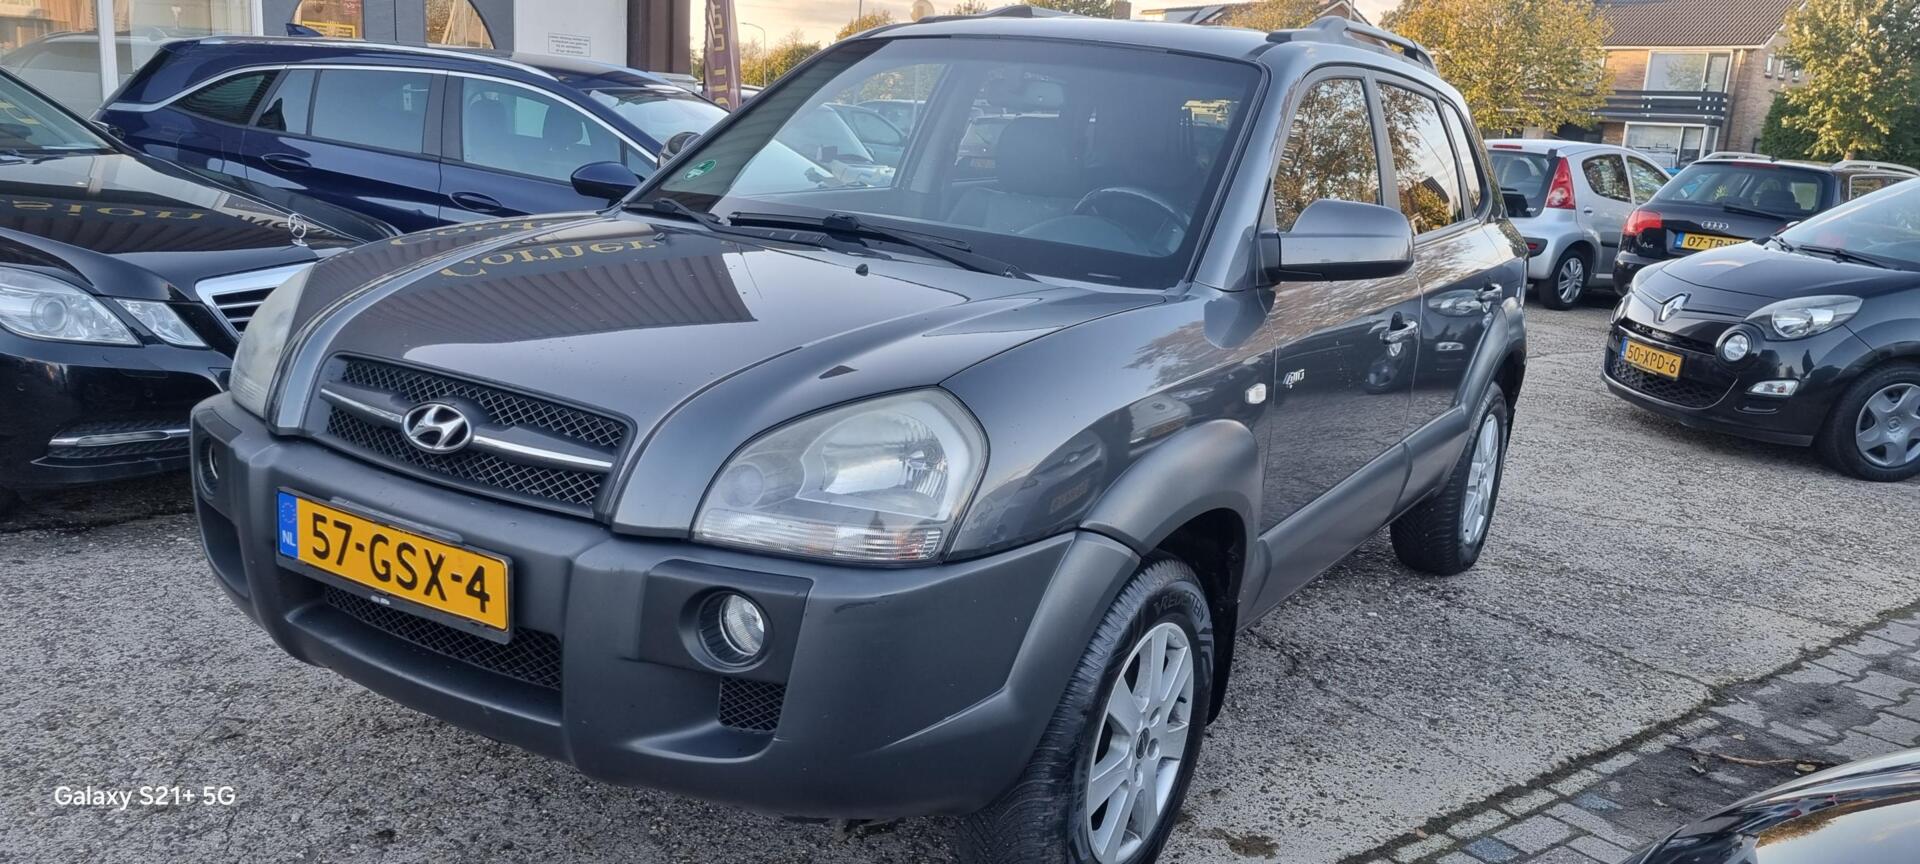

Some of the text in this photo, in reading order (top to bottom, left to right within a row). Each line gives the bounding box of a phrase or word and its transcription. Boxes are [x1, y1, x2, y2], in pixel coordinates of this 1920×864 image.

[1627, 344, 1677, 374] 50-XPD-6
[282, 530, 296, 547] NL
[312, 512, 491, 614] 57-GSX-4
